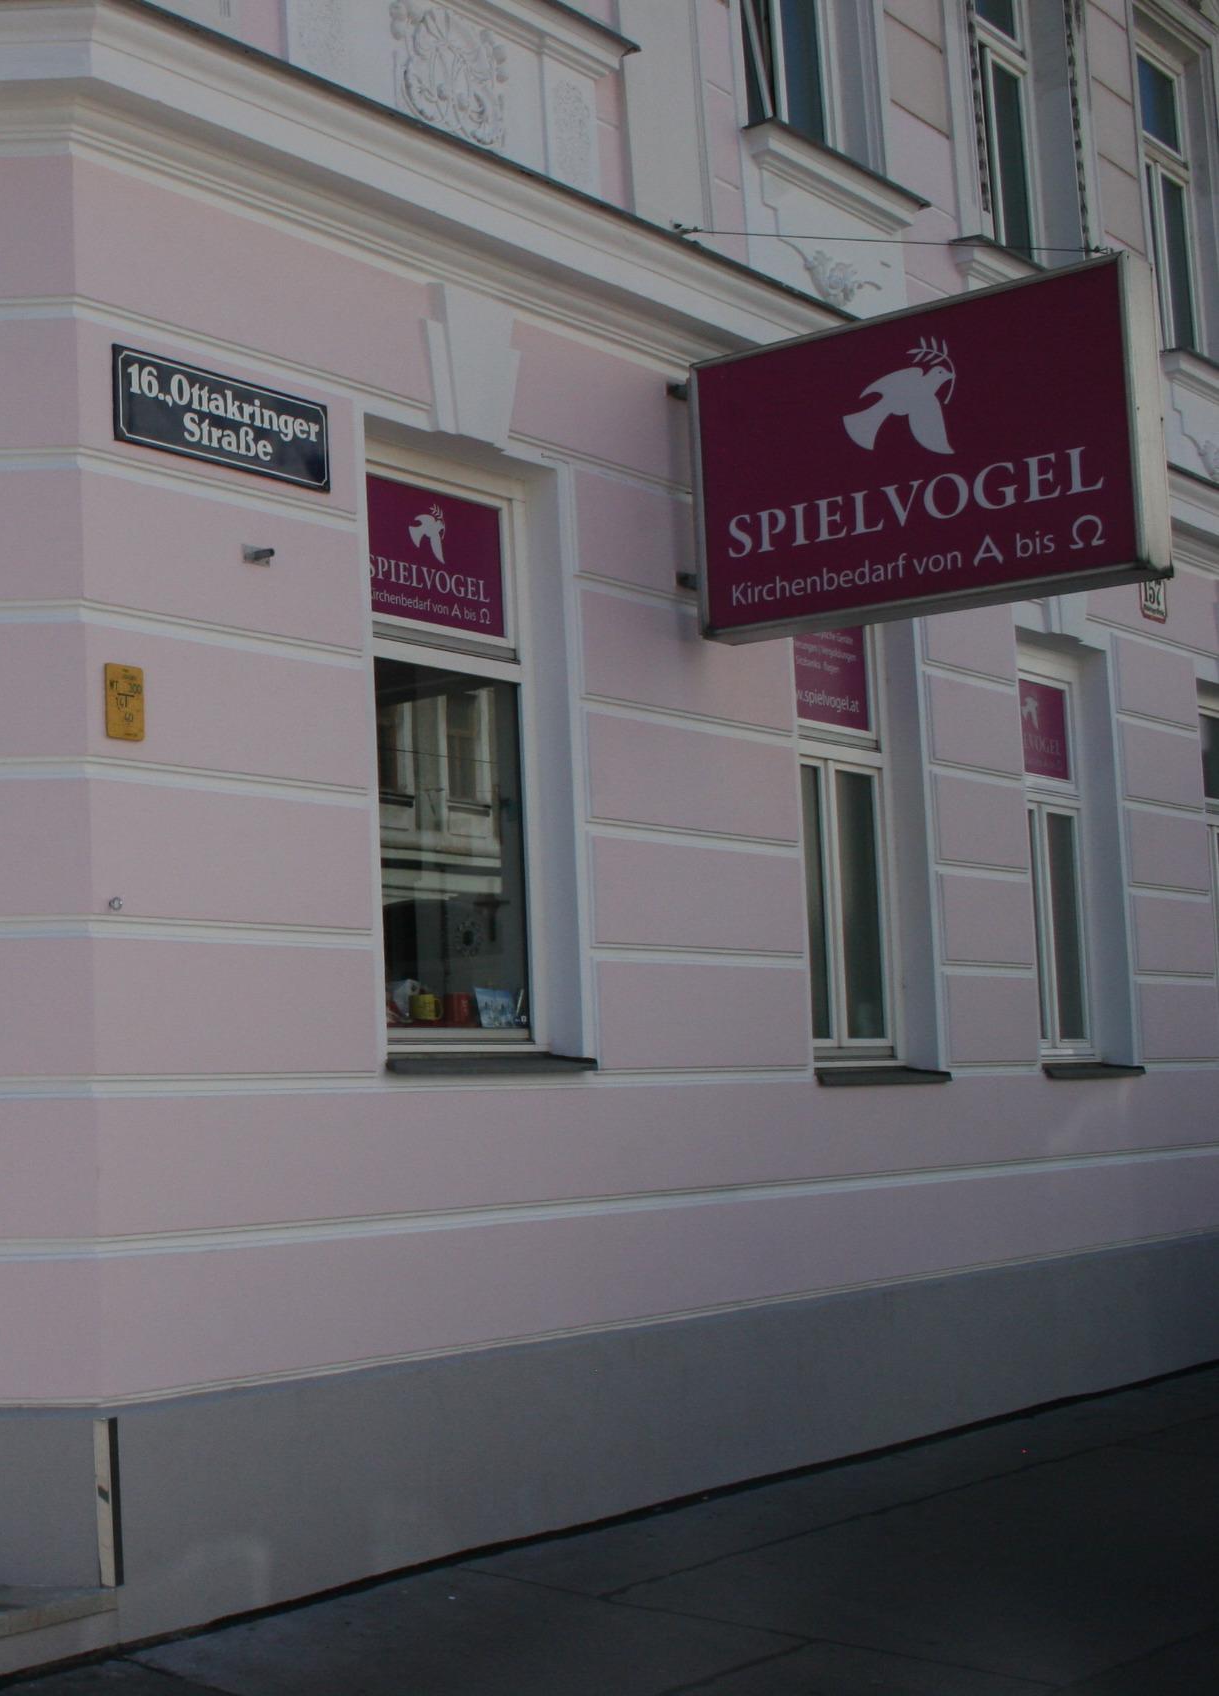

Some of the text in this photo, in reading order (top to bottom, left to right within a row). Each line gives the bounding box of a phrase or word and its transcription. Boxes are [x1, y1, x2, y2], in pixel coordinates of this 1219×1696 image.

[183, 412, 273, 461] Straße
[728, 446, 1104, 558] SPIELVOGEL
[369, 554, 490, 603] SPIELVOGEL
[732, 553, 907, 606] Kirchenbedarf
[912, 551, 962, 576] von
[973, 536, 1005, 566] A
[1016, 530, 1055, 558] bis
[432, 603, 449, 616] von
[451, 603, 462, 619] A
[464, 607, 477, 621] bis
